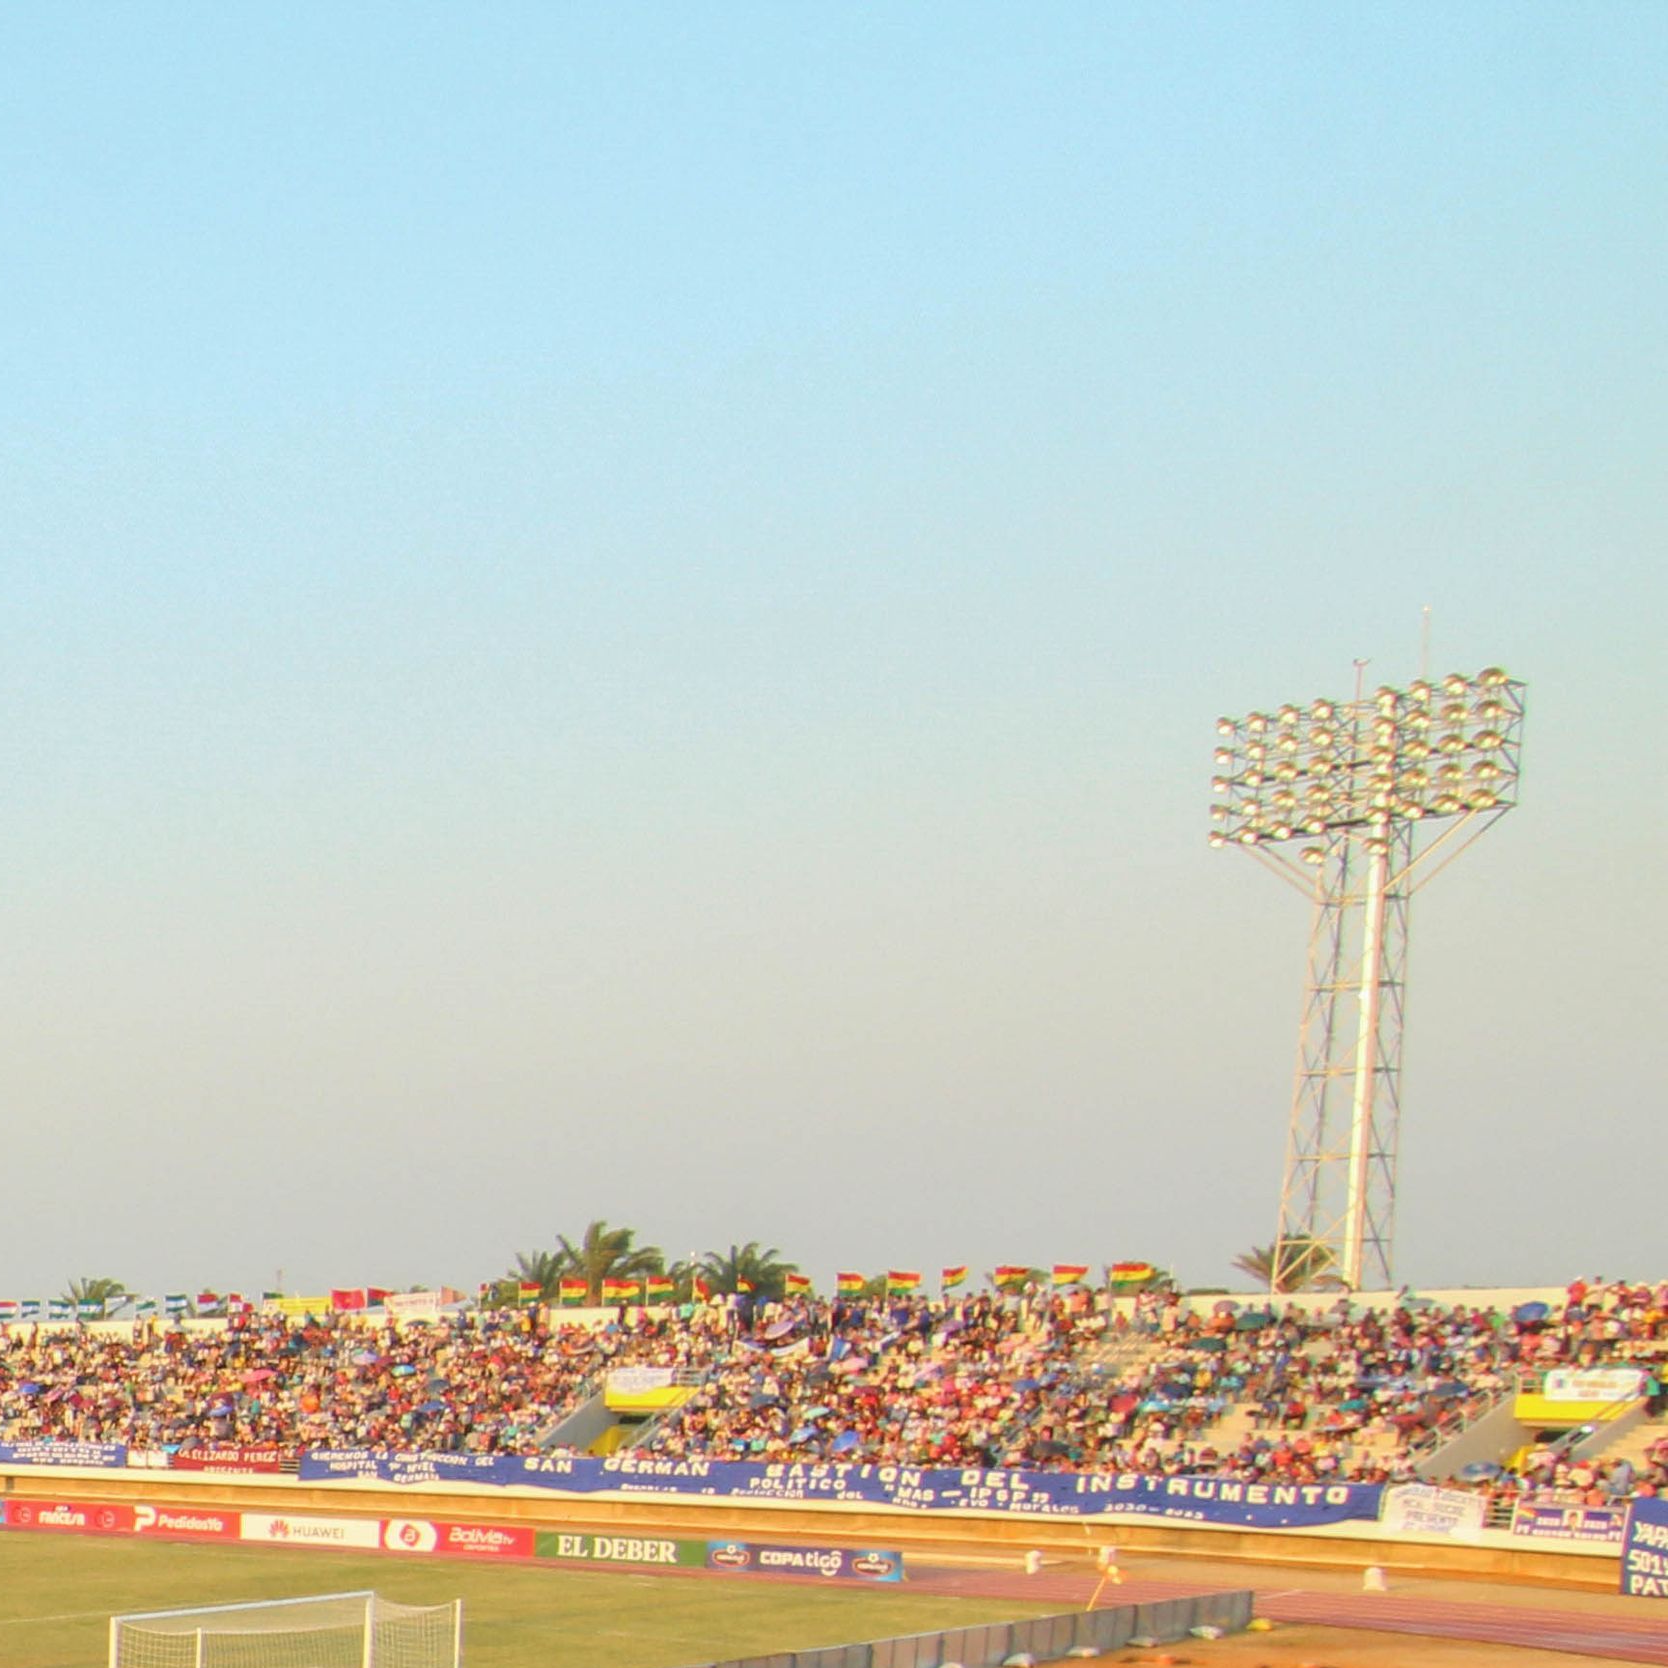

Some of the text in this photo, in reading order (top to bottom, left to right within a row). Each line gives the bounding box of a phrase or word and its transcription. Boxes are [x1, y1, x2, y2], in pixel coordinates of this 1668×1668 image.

[524, 1457, 1350, 1505] SAN GERMAN BASTION DEL INSTRUMENTO
[749, 1477, 847, 1491] POLITICO
[158, 1514, 224, 1533] PedidosYa
[292, 1527, 345, 1540] HUAWEI
[557, 1535, 678, 1564] EL DEBER
[759, 1551, 804, 1567] COPA
